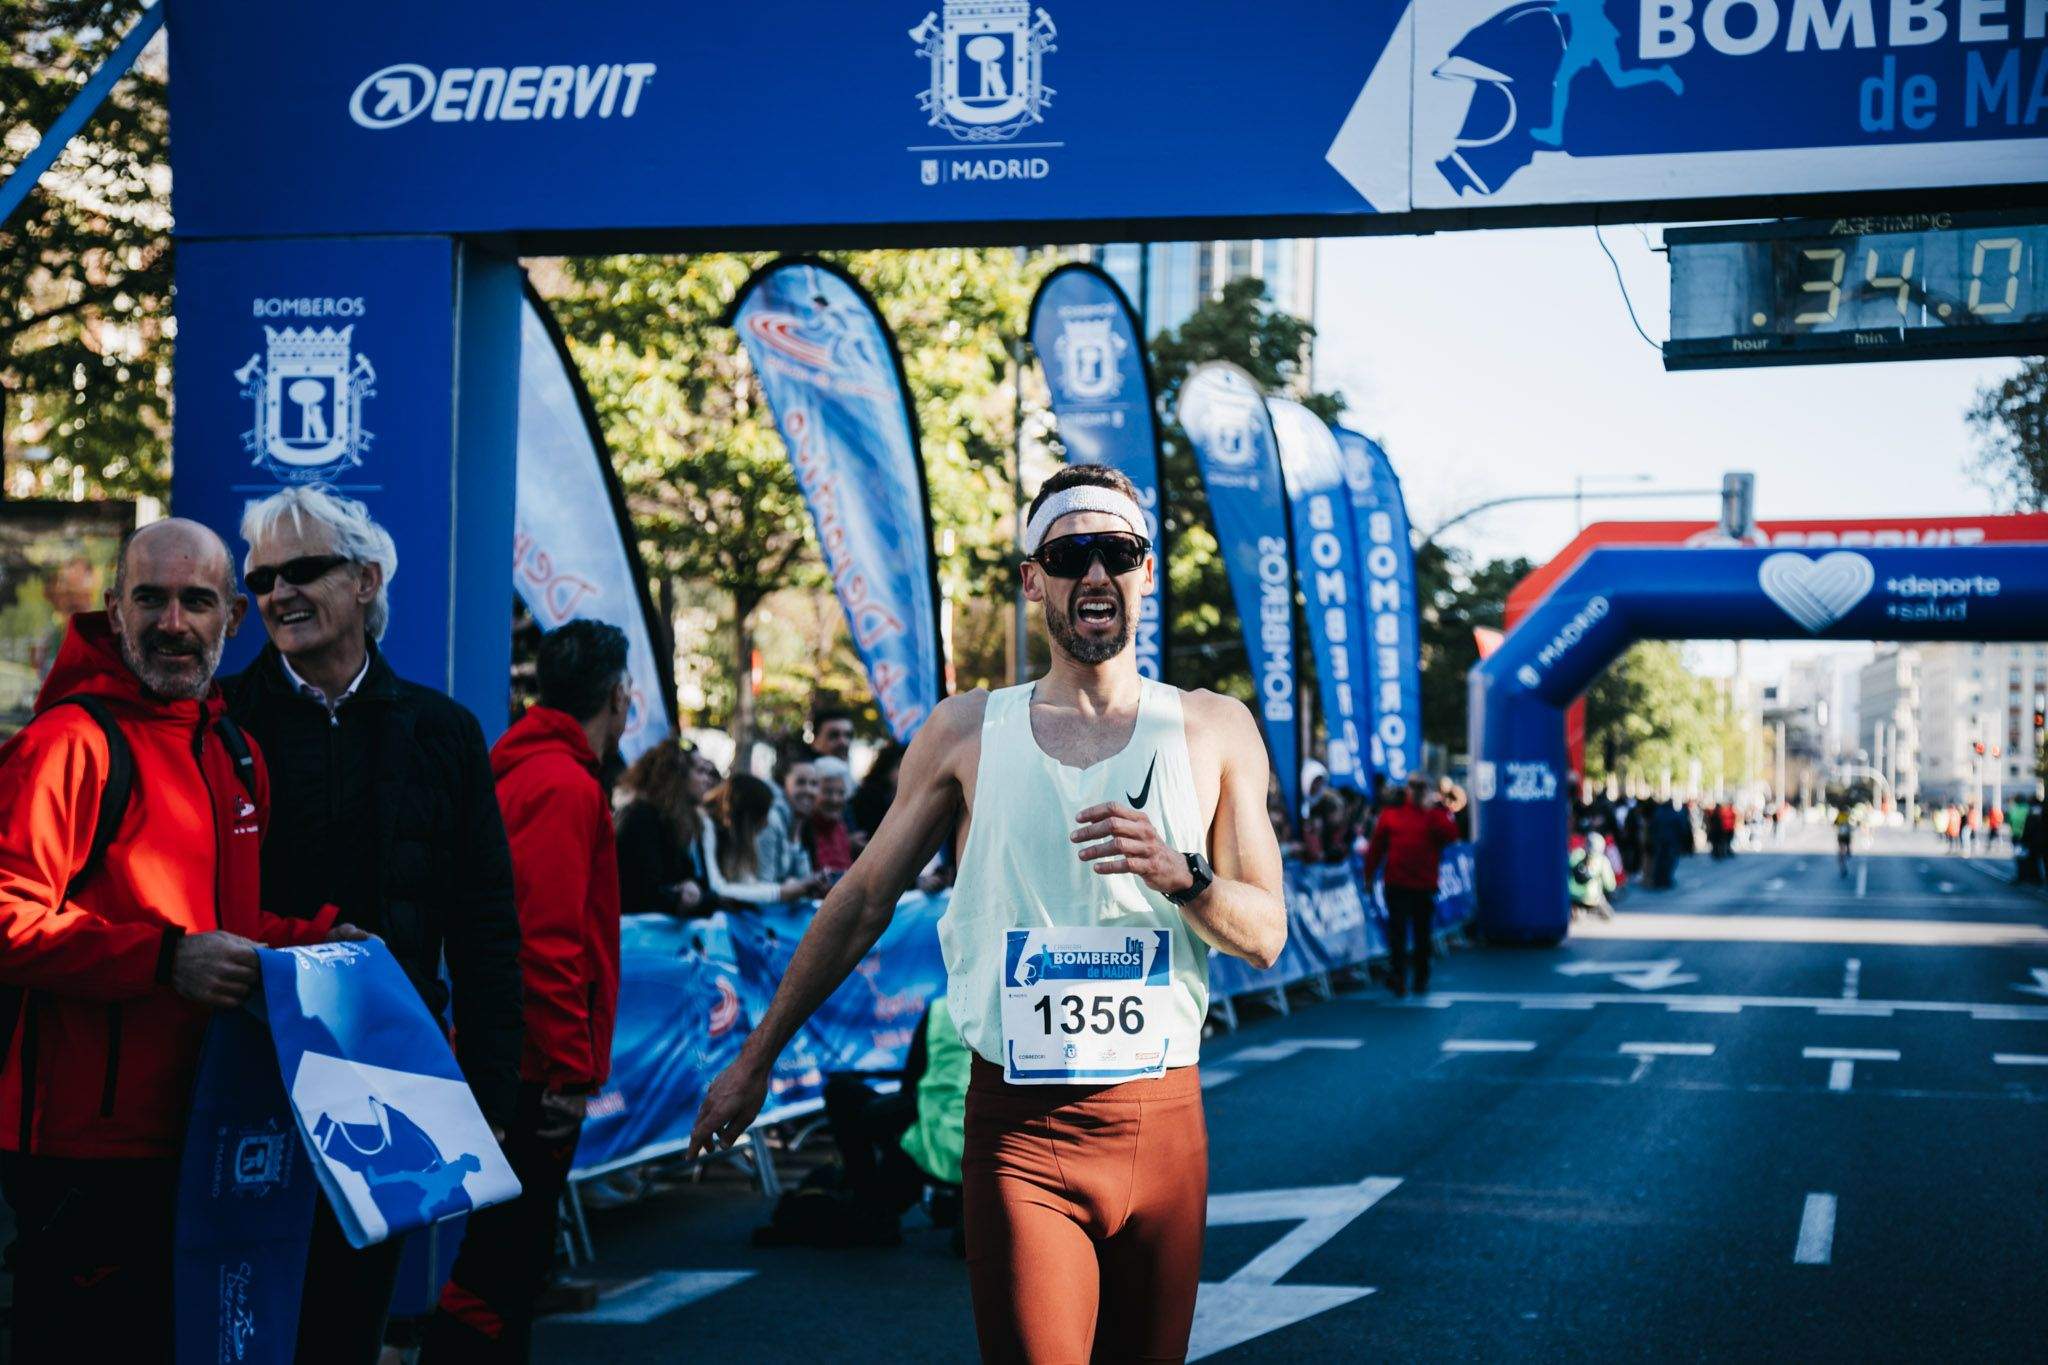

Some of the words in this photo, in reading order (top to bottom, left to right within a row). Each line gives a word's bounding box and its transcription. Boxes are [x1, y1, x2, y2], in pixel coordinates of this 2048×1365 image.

[431, 63, 657, 122] ENERVIT
[1860, 54, 1938, 133] de
[952, 158, 1049, 181] MADRID
[253, 297, 366, 318] BOMBEROS
[1732, 338, 1769, 351] hour
[1855, 332, 1888, 345] min.
[1538, 595, 1610, 669] MADRID
[1053, 952, 1141, 965] BOMBEROS
[1087, 966, 1099, 978] de
[1102, 967, 1141, 979] MADRID
[1034, 995, 1145, 1035] 1356
